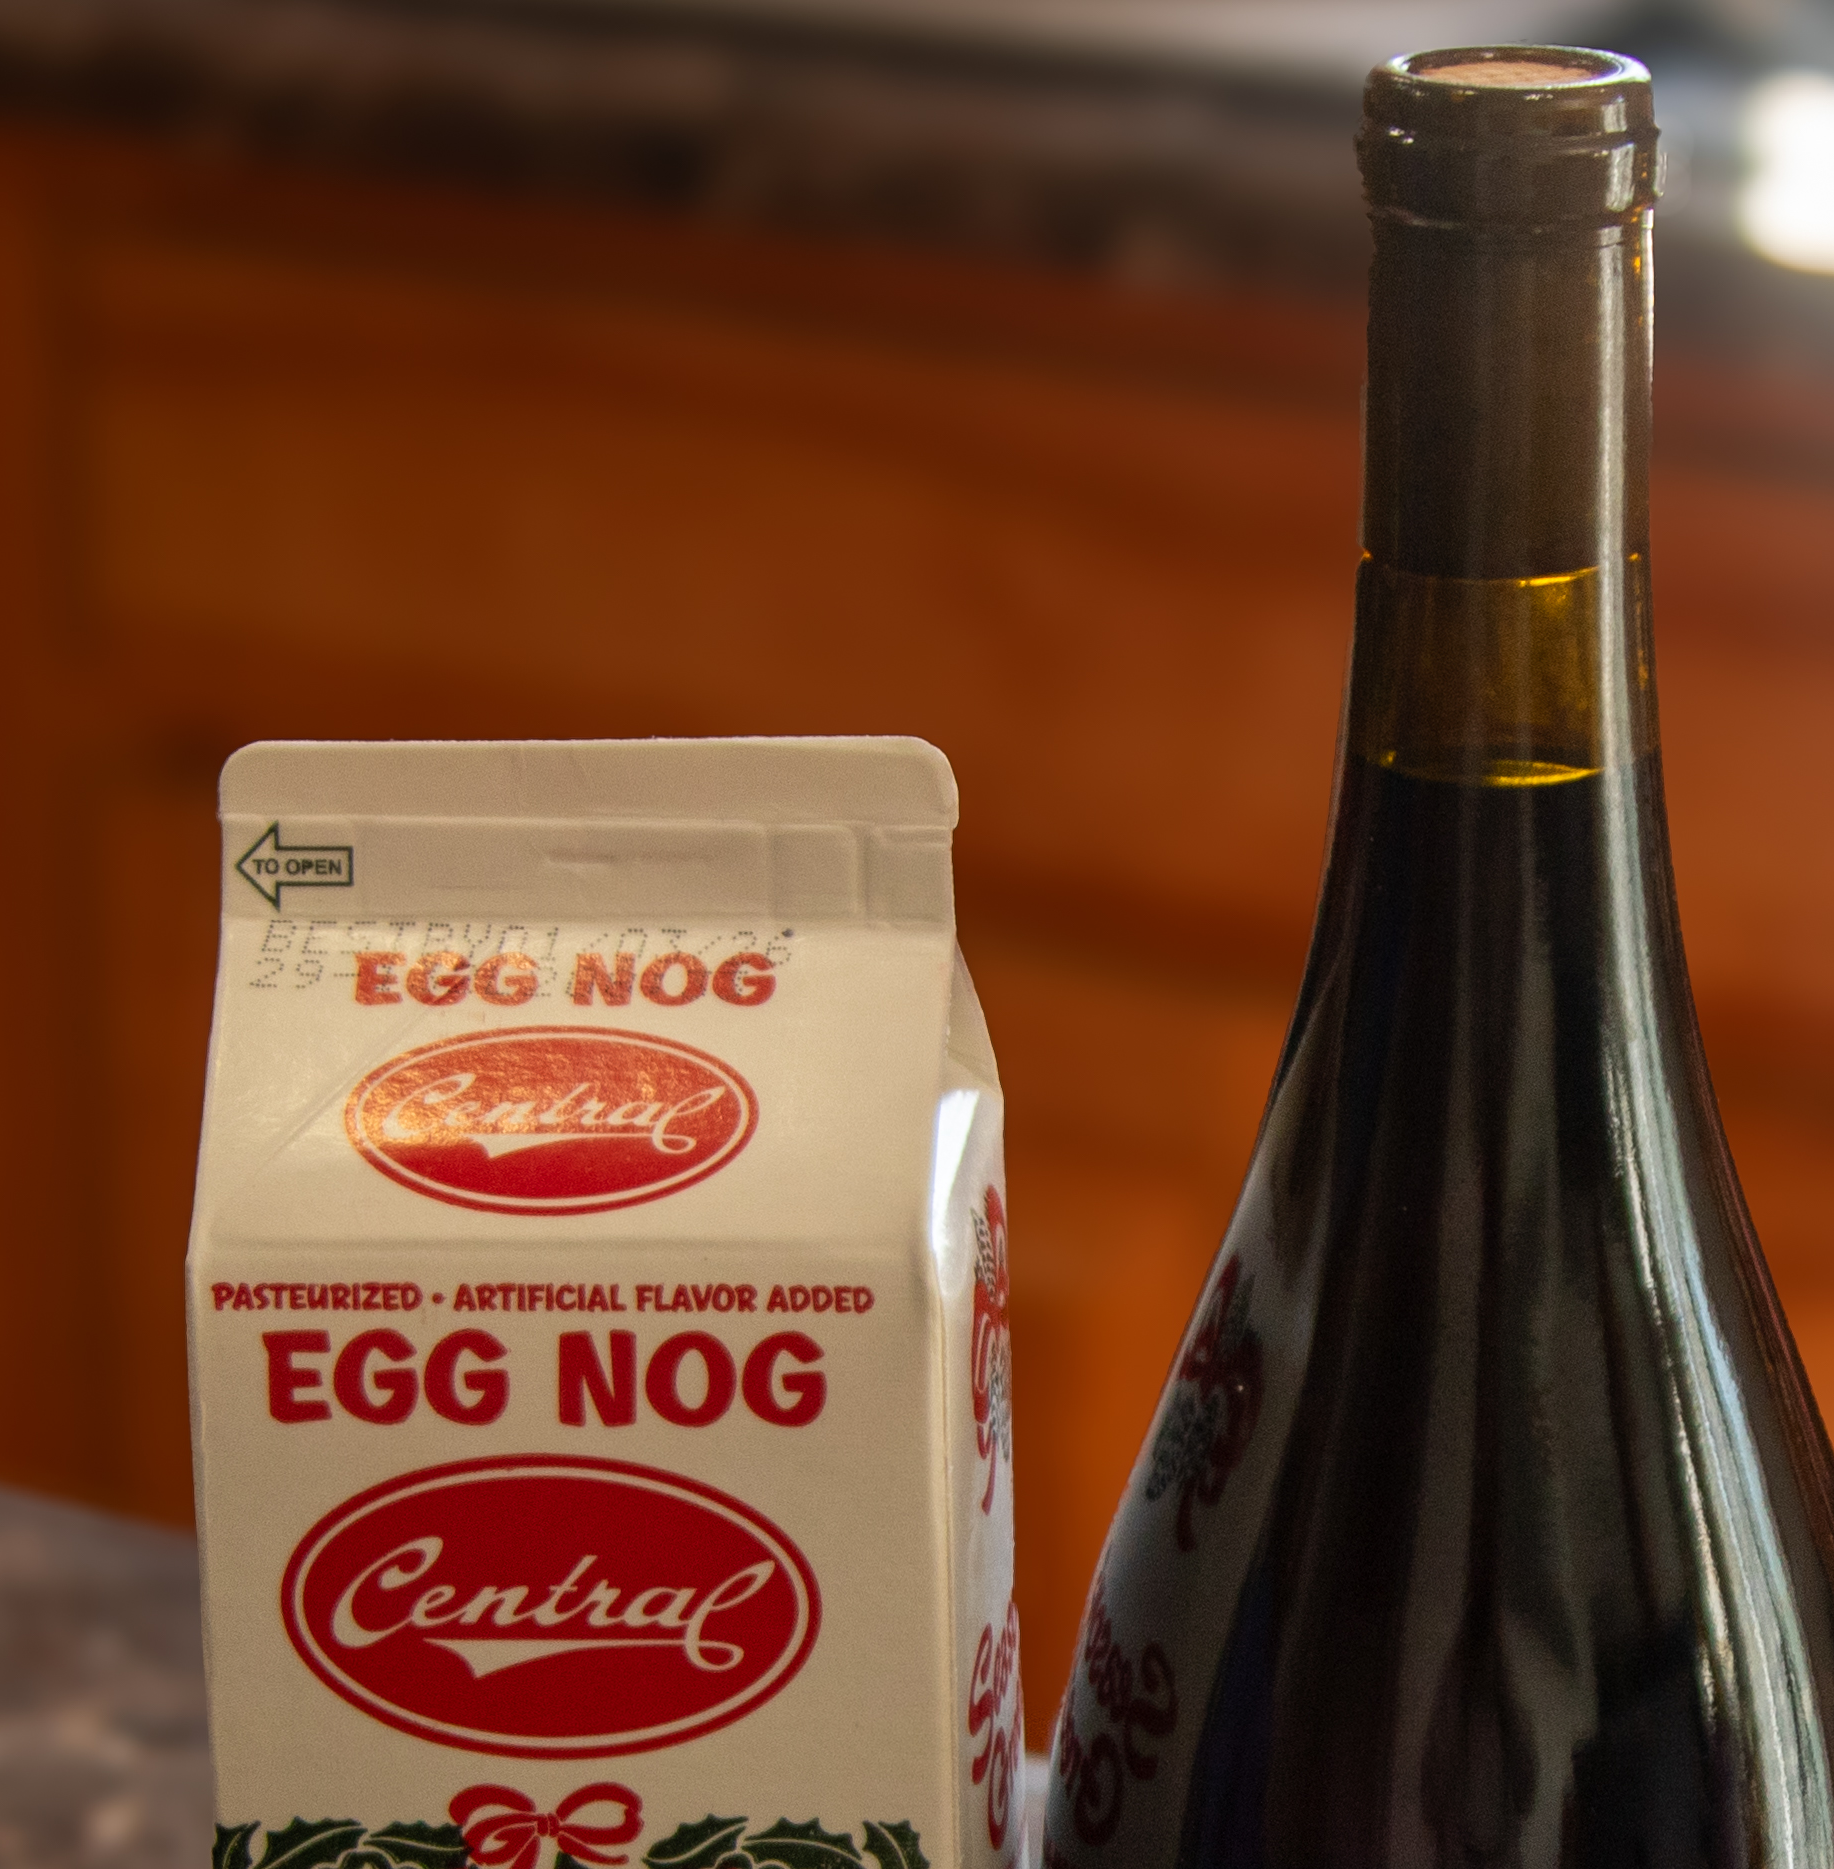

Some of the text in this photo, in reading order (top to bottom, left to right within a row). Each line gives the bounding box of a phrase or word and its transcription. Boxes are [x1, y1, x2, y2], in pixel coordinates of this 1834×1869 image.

[252, 858, 342, 875] TO OPEN
[352, 951, 540, 1006] EGG
[573, 952, 777, 1006] NOG
[380, 1072, 726, 1155] Central
[211, 1282, 876, 1314] PASTEURIZED ARTIFICIAL FLAVOR ADDED
[262, 1328, 828, 1427] EGG NOG
[332, 1536, 776, 1672] Central
